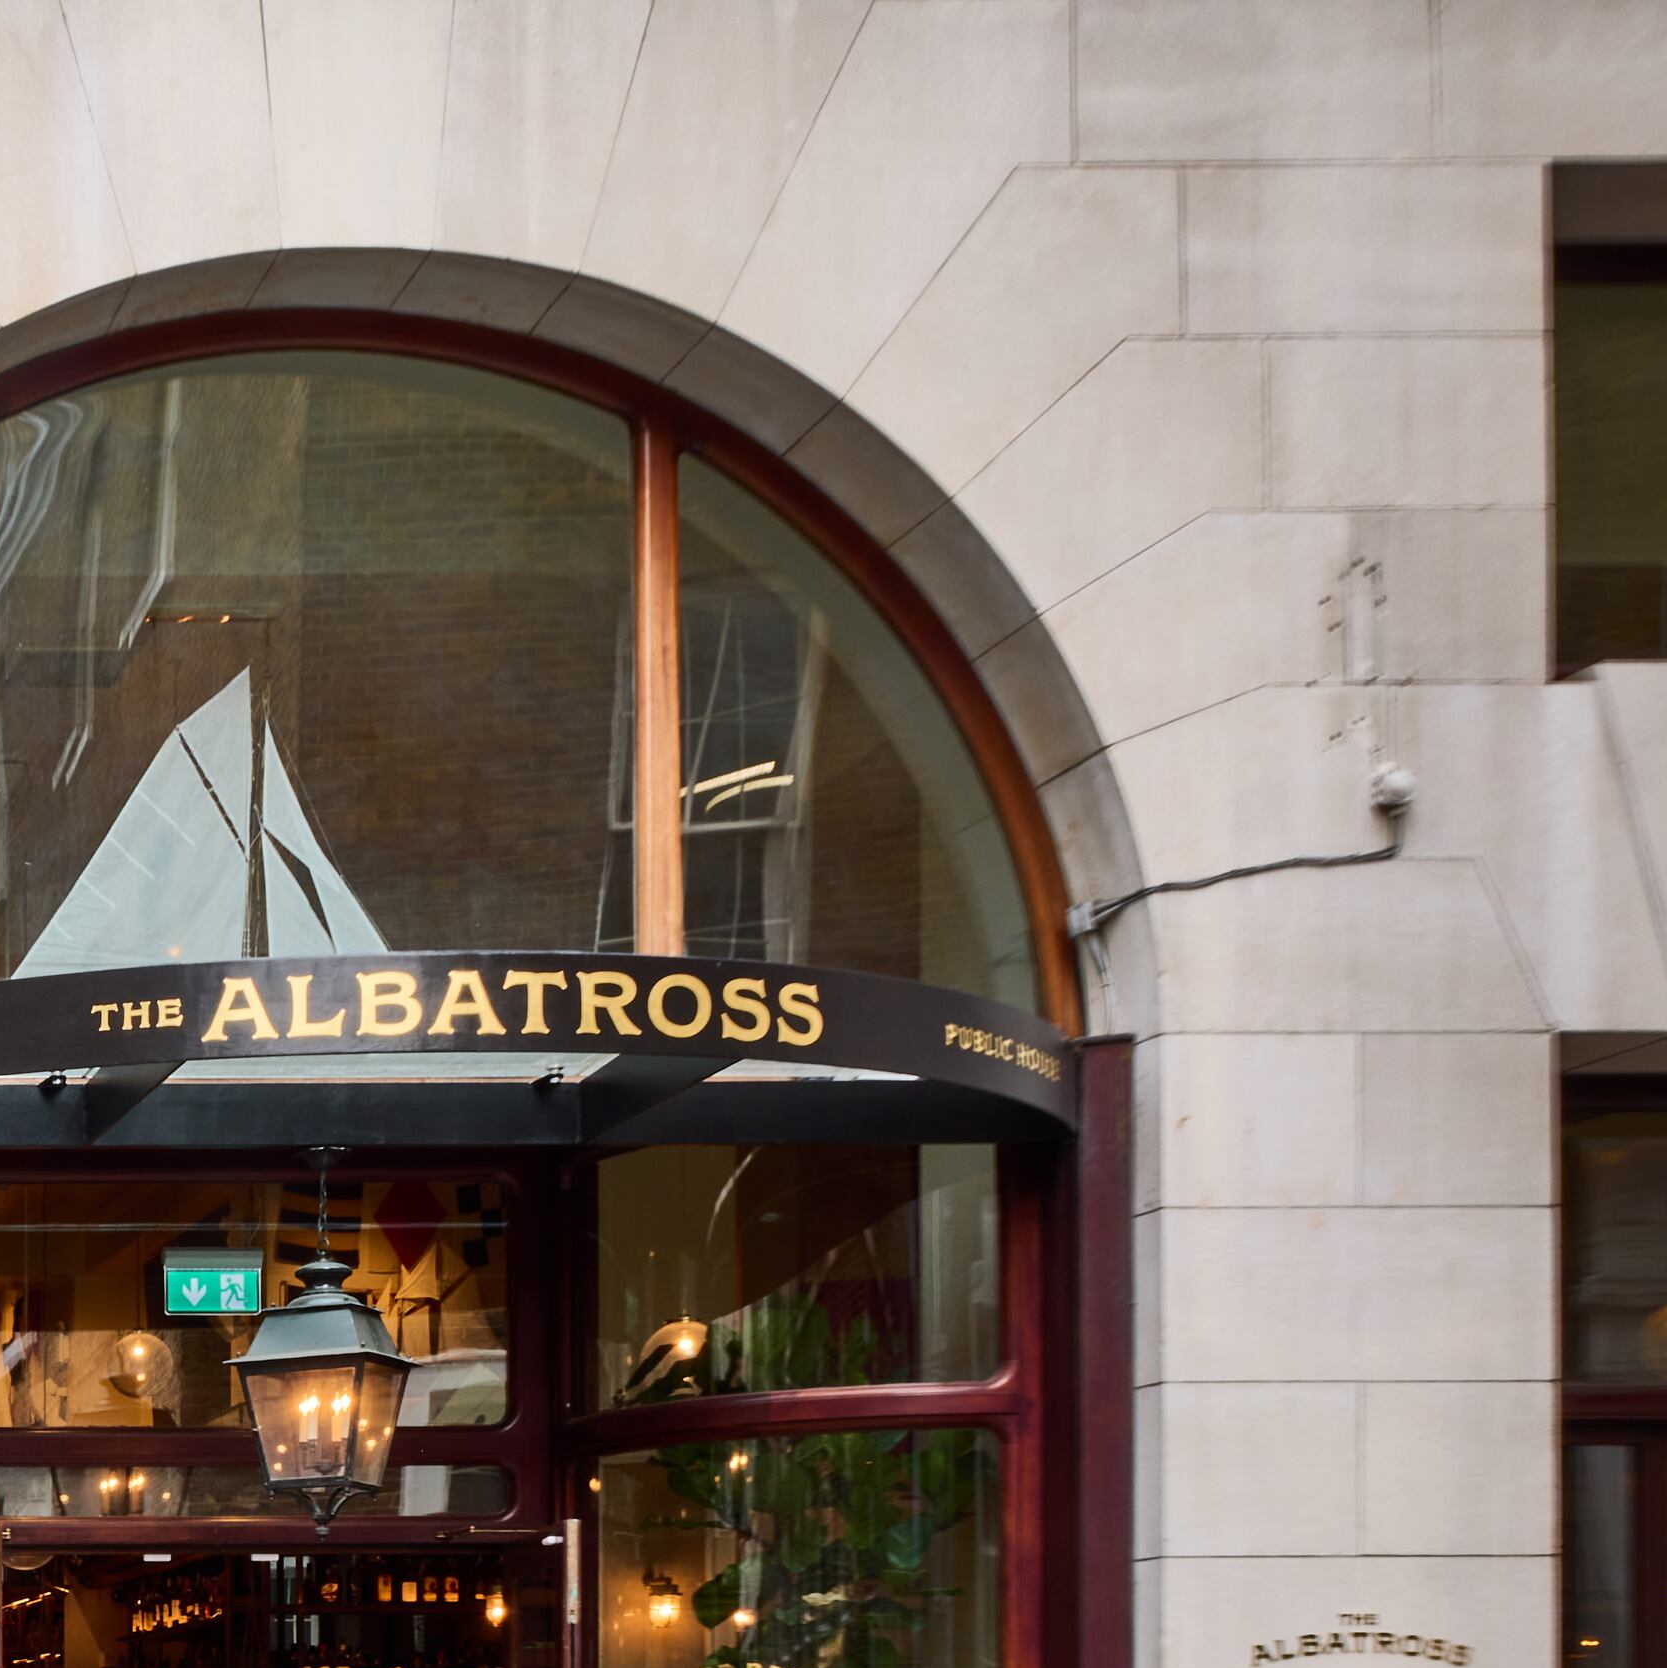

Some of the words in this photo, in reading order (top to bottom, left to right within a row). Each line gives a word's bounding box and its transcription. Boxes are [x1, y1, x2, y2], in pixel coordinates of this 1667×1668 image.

[91, 997, 184, 1033] THE
[200, 969, 825, 1047] ALBATROSS
[944, 1023, 1014, 1061] PUBLIC
[1337, 1613, 1379, 1625] THE
[1250, 1632, 1473, 1668] ALBATROSS
